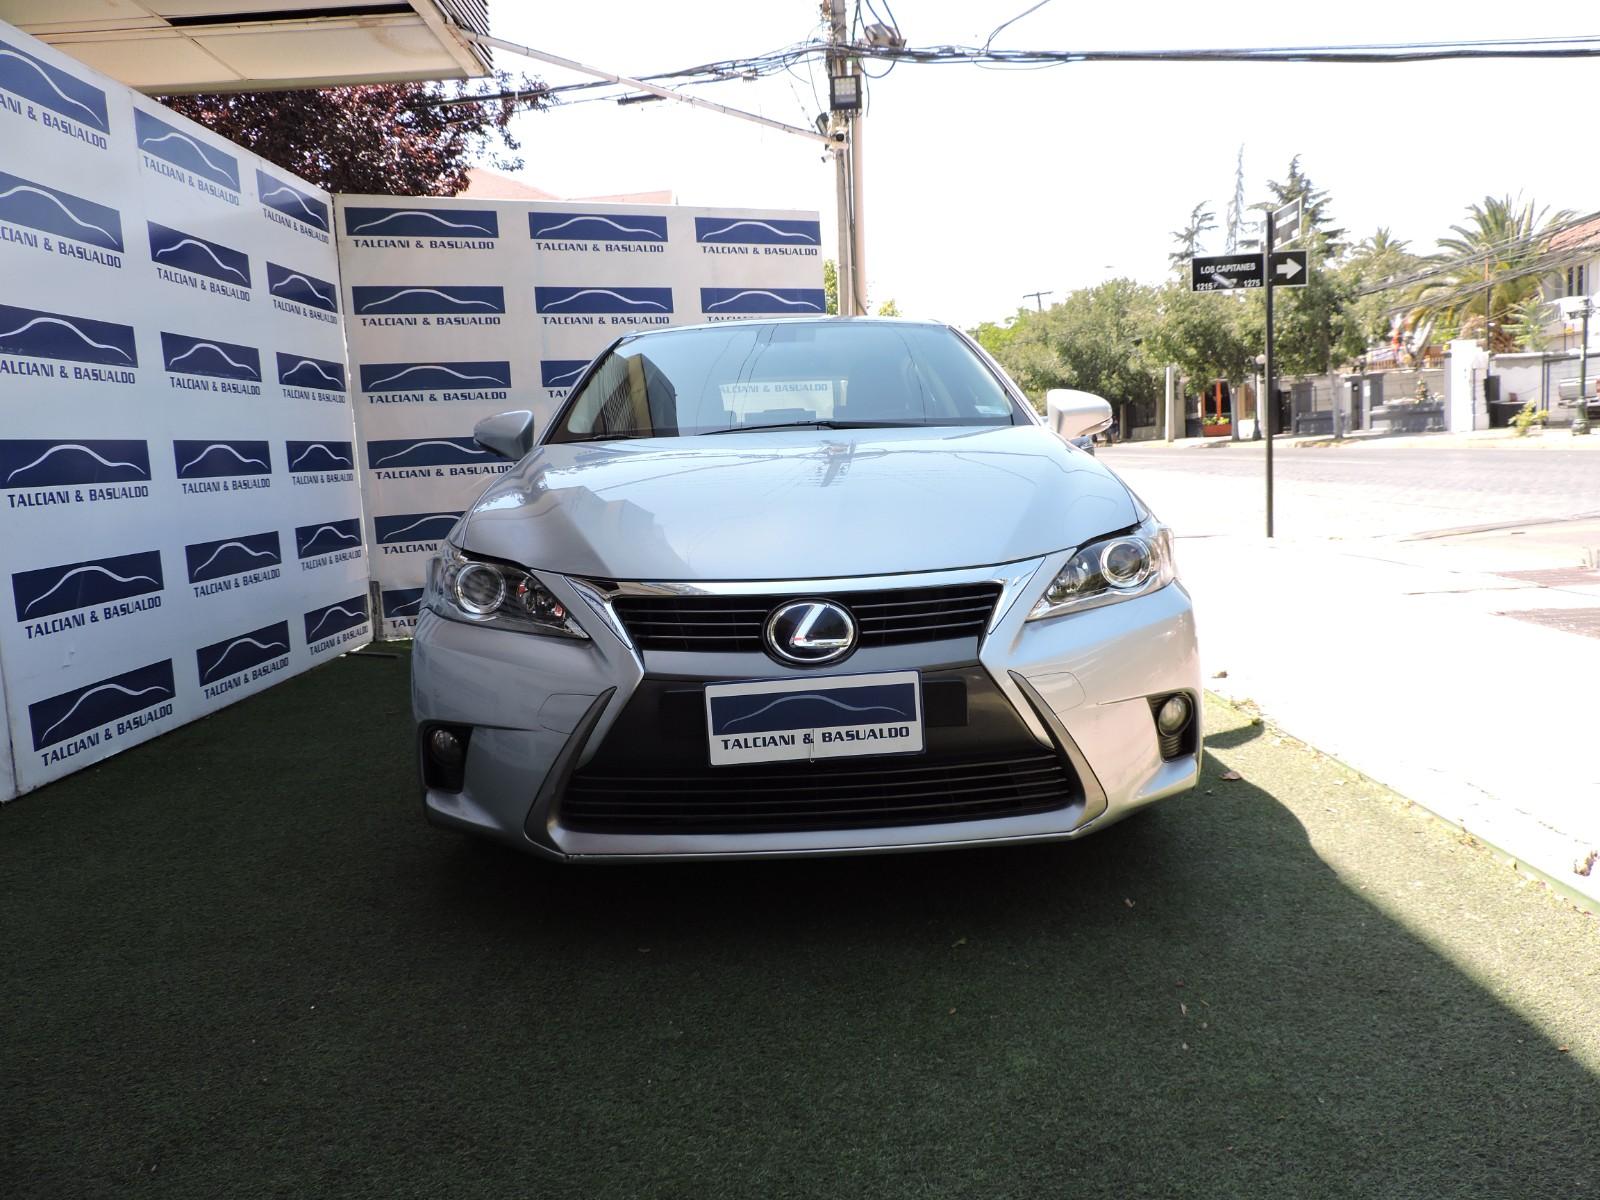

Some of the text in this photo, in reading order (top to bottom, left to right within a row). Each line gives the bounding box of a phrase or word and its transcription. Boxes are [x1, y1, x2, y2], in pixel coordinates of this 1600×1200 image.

[27, 105, 38, 122] &
[42, 111, 107, 150] BASUALDO
[143, 156, 240, 206] TALCIANI & BASUALDO
[263, 208, 292, 229] TALCIANI
[0, 225, 122, 268] CIANI & BASUALDO
[353, 239, 495, 250] TALCIANI & BASUALDO
[536, 242, 664, 253] TALCIANI & BASUALDO
[702, 245, 818, 256] TALCIANI & BASUALDO
[1200, 262, 1256, 274] LOS CAPITANES
[157, 267, 250, 302] TALCIANI & BASUALDO
[273, 299, 301, 315] TALCIANI
[361, 316, 501, 327] TALCIANI & BASUALDO
[543, 316, 670, 325] TALCIANI & BASUALDO
[59, 365, 69, 379] &
[74, 366, 136, 384] BASUALDO
[170, 376, 261, 396] TALCIANI & BASUALDO
[283, 388, 310, 400] TALCIANI
[368, 391, 507, 404] TALCIANI & BASUALDO
[292, 474, 319, 486] TALCIANI
[375, 469, 431, 480] TALCIANI
[436, 468, 444, 477] &
[182, 478, 271, 495] TALCIANI & BASUALDO
[7, 485, 149, 509] TALCIANI & BASUALDO
[382, 543, 438, 555] TALCIANI
[301, 557, 328, 571] TALCIANI
[193, 568, 281, 599] TALCIANI & BASUALDO
[25, 596, 162, 639] TALCIANI & BASUALDO
[204, 657, 289, 700] TALCIANI & BASUALDO
[41, 703, 173, 767] TALCIANI & BASUALDO
[721, 726, 910, 751] TALCIANI & BASUALDO
